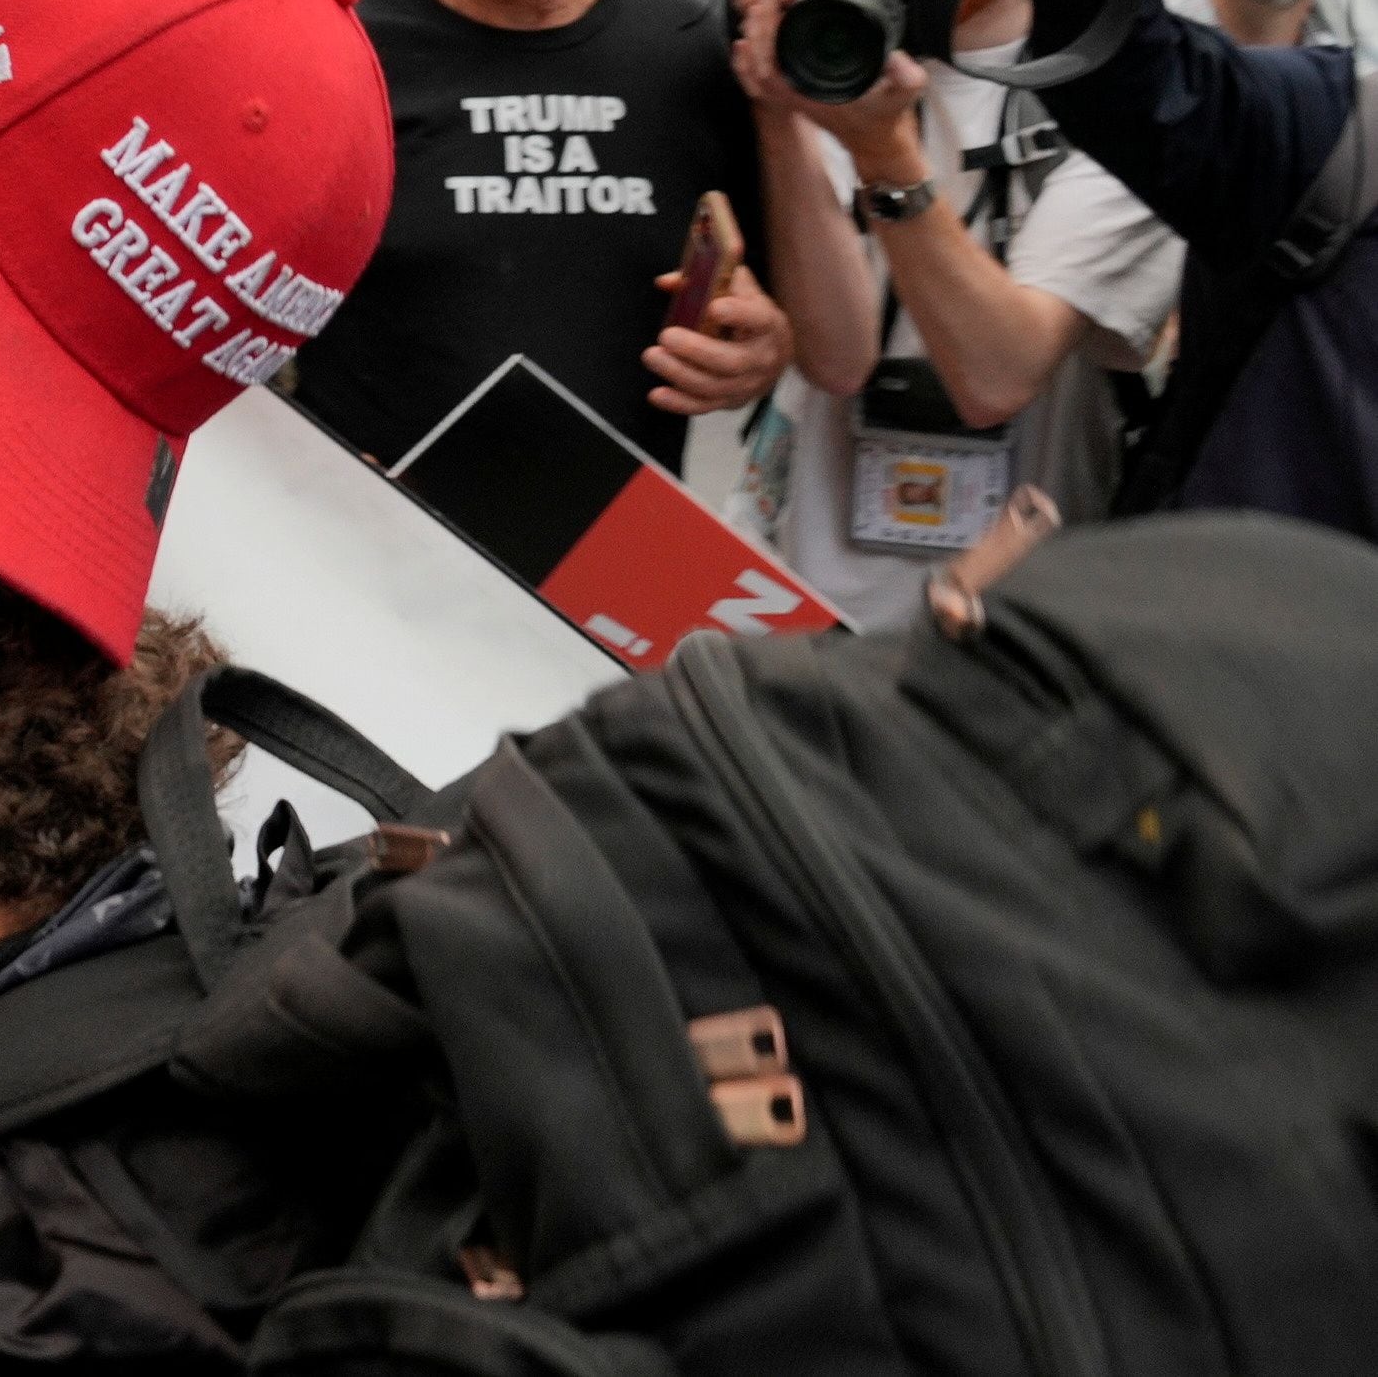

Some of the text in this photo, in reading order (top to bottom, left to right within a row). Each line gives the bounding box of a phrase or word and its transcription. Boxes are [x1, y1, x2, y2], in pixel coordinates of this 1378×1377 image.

[460, 94, 626, 135] TRUMP
[504, 135, 599, 174] IS A
[445, 175, 657, 216] TRAITOR
[99, 115, 345, 338] MAKE AMER
[70, 196, 231, 350] GREAT
